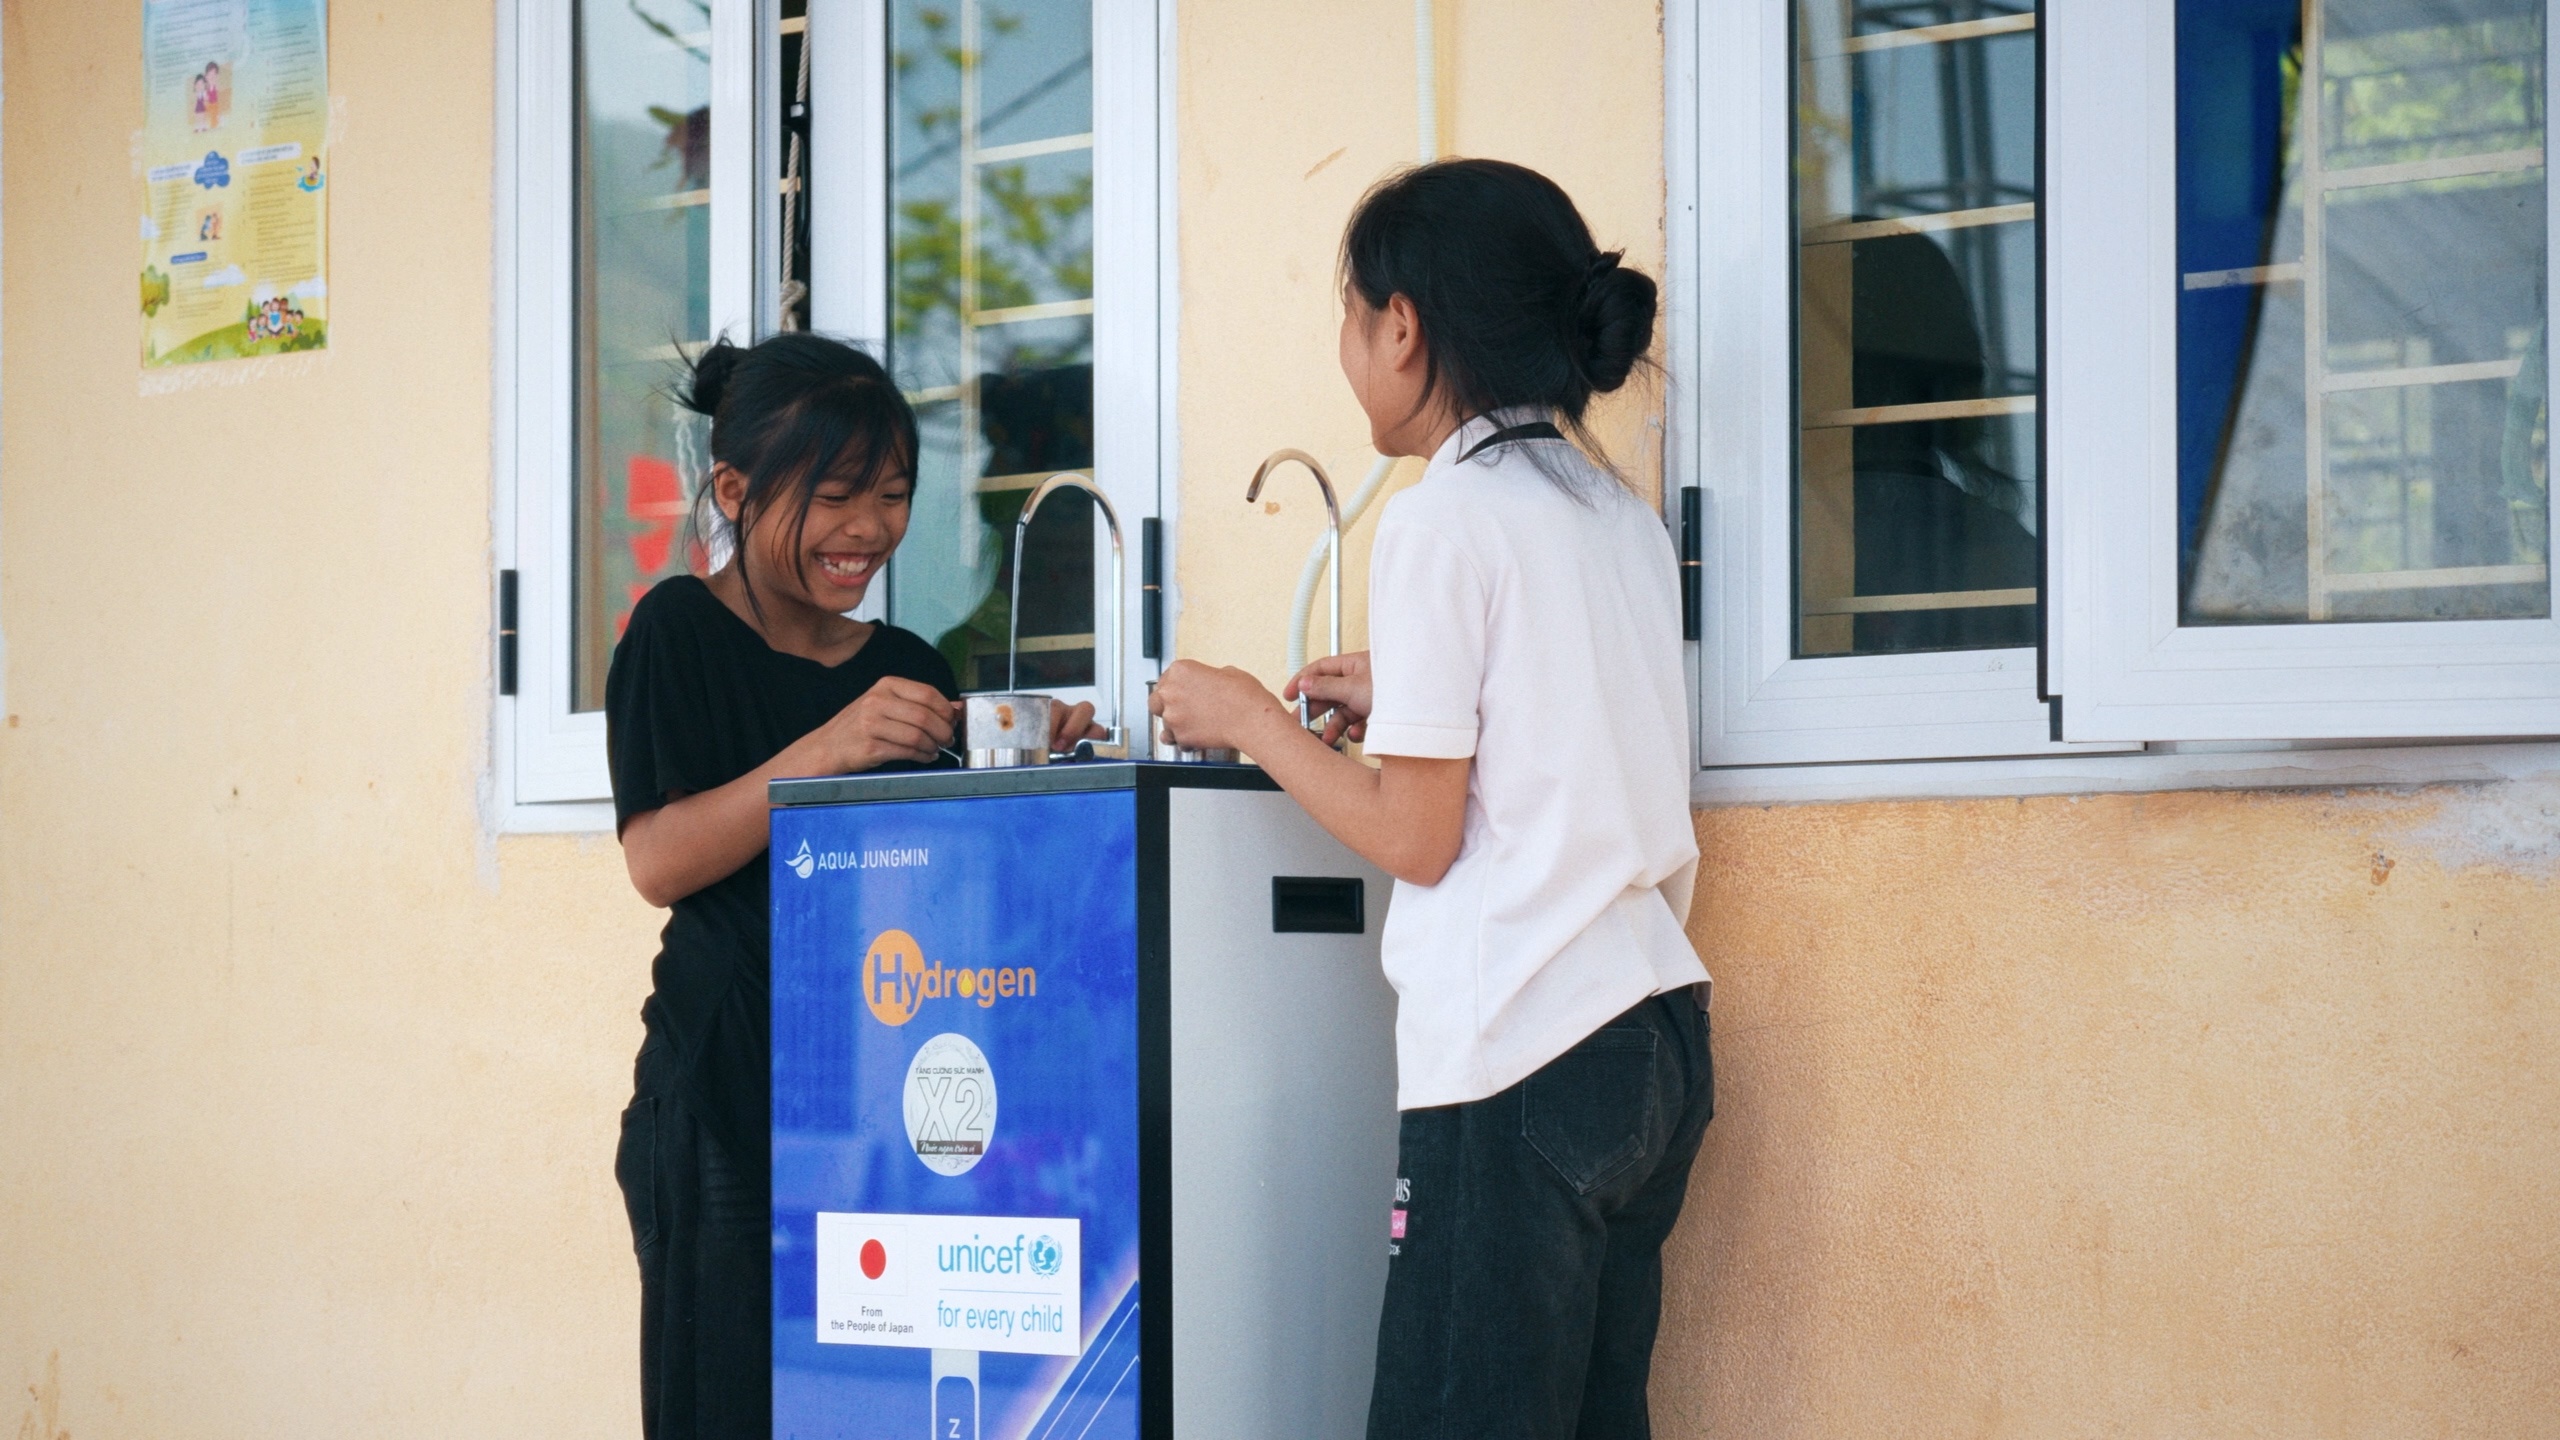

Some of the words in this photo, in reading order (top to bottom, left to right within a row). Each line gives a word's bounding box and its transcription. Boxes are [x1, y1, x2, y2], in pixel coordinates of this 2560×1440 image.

[818, 851, 858, 870] AQUA
[860, 848, 929, 869] JUNGMIN
[873, 953, 1037, 1015] Hydrogen
[917, 1077, 984, 1141] X2
[938, 1234, 1025, 1274] unicef
[861, 1305, 883, 1317] From
[937, 1300, 961, 1328] for
[966, 1308, 1016, 1338] every
[1021, 1304, 1063, 1333] child
[830, 1319, 845, 1331] the
[847, 1319, 876, 1333] People
[878, 1321, 887, 1332] of
[888, 1322, 914, 1335] Japan
[949, 1418, 961, 1439] Z
